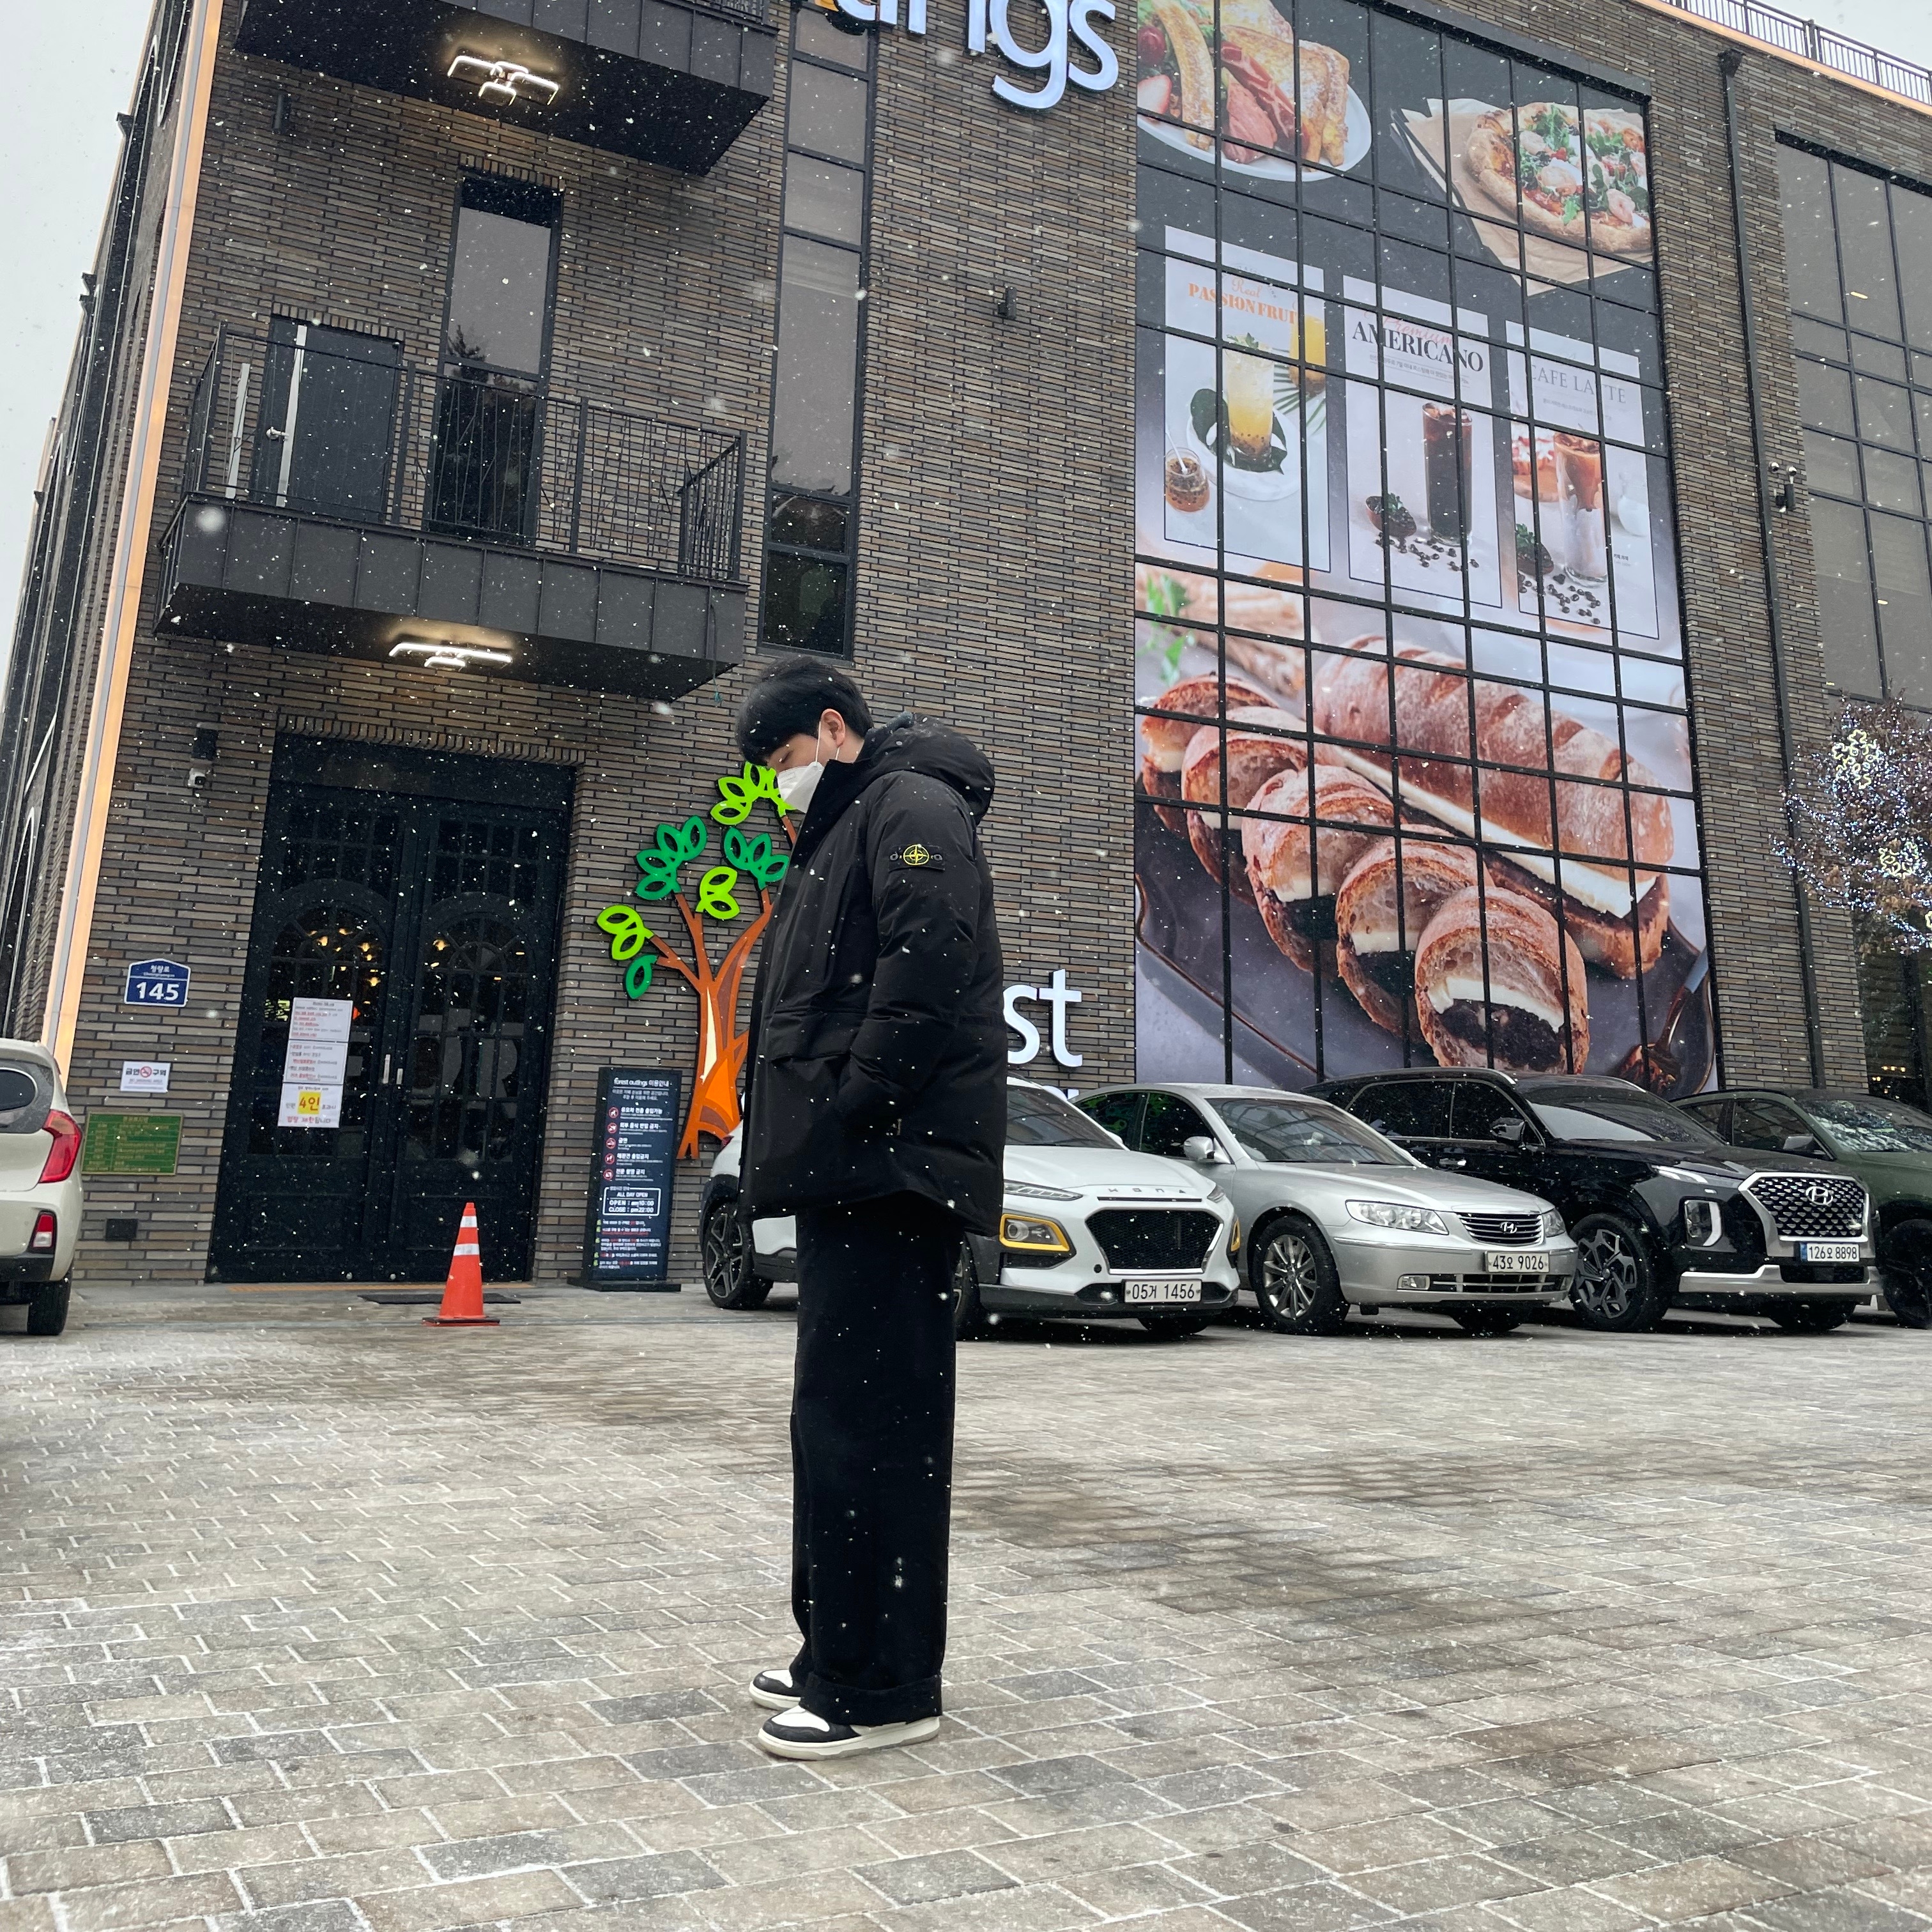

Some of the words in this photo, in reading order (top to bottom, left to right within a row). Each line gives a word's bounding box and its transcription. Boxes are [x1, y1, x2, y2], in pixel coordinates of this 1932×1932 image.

[1188, 282, 1255, 314] PASSION
[1353, 321, 1483, 372] AMERICANO
[1574, 376, 1626, 404] LATE
[136, 981, 180, 1001] 145
[298, 1096, 320, 1111] 4인
[1809, 1246, 1833, 1259] 126오
[1835, 1246, 1857, 1259] 8898
[1492, 1255, 1513, 1269] 43오
[1518, 1255, 1544, 1270] 9026
[1132, 1284, 1157, 1300] 05거
[1163, 1284, 1195, 1300] 1456
